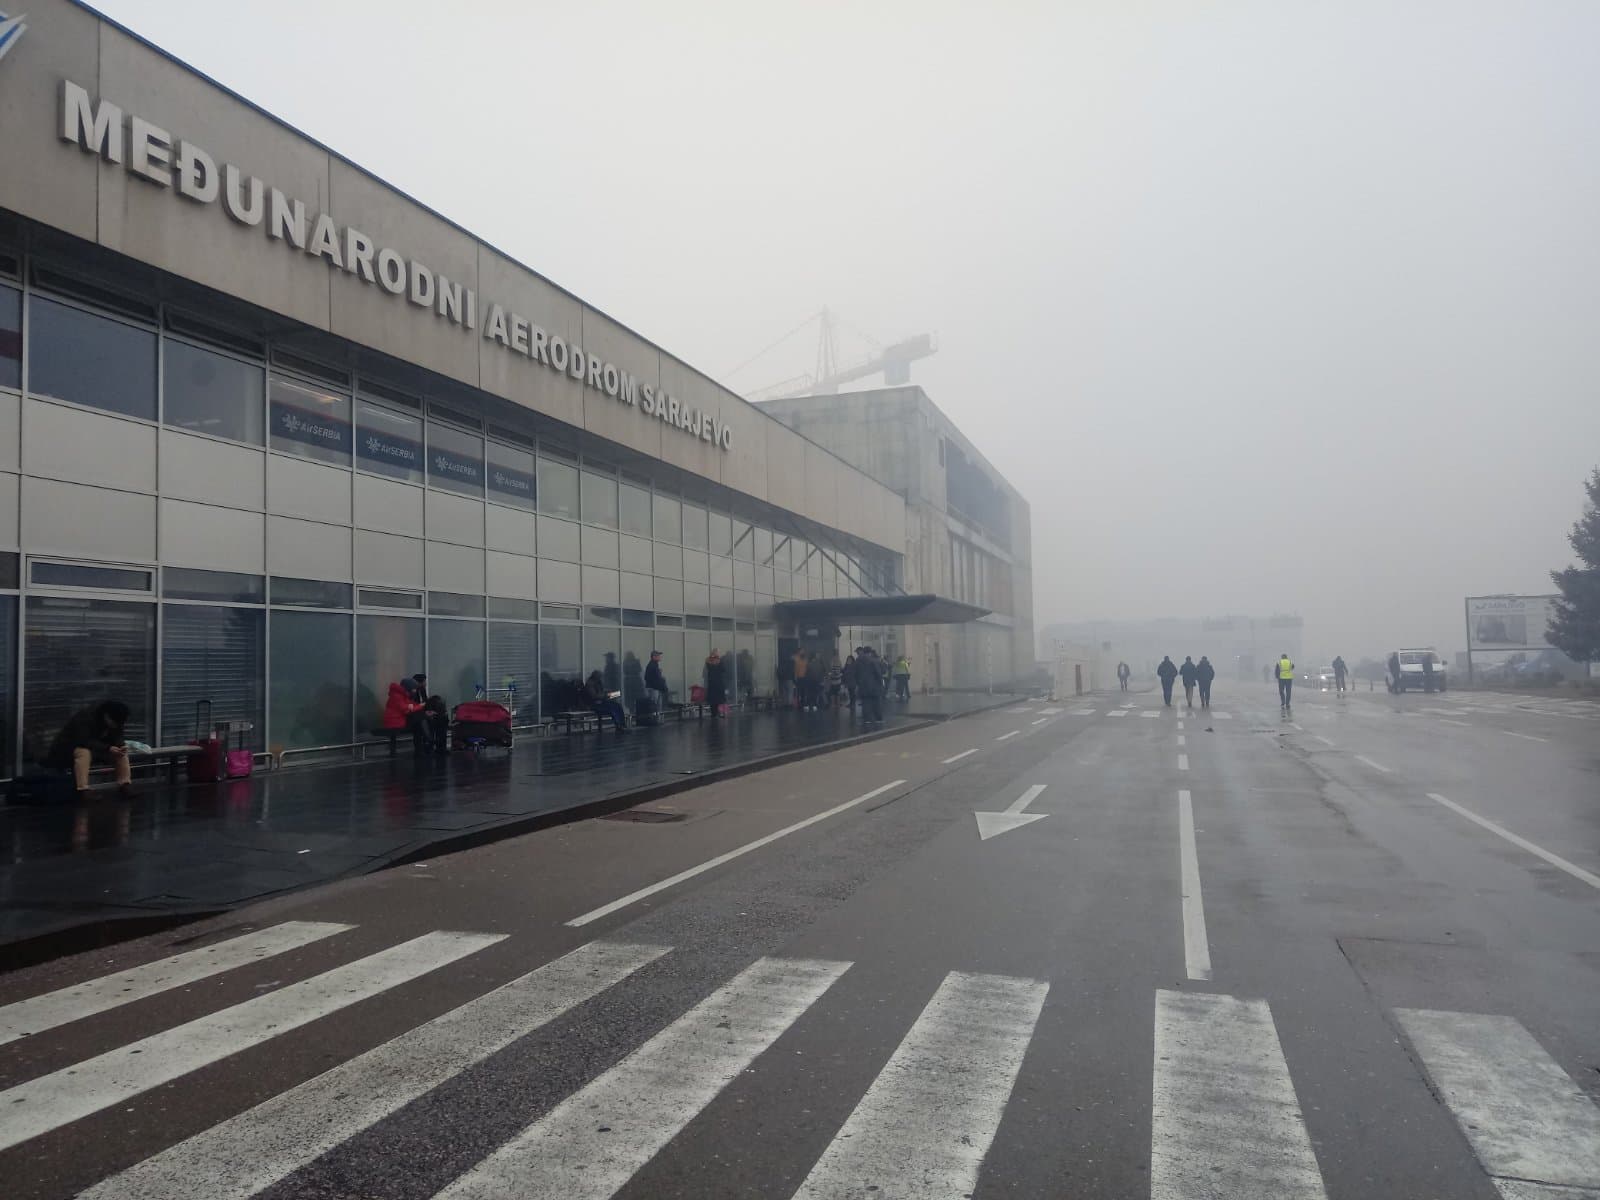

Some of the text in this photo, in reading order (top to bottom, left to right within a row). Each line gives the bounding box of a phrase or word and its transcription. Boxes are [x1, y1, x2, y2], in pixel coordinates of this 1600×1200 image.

[60, 79, 732, 449] MEĐUNARODNI AERODROM SARAJEVO
